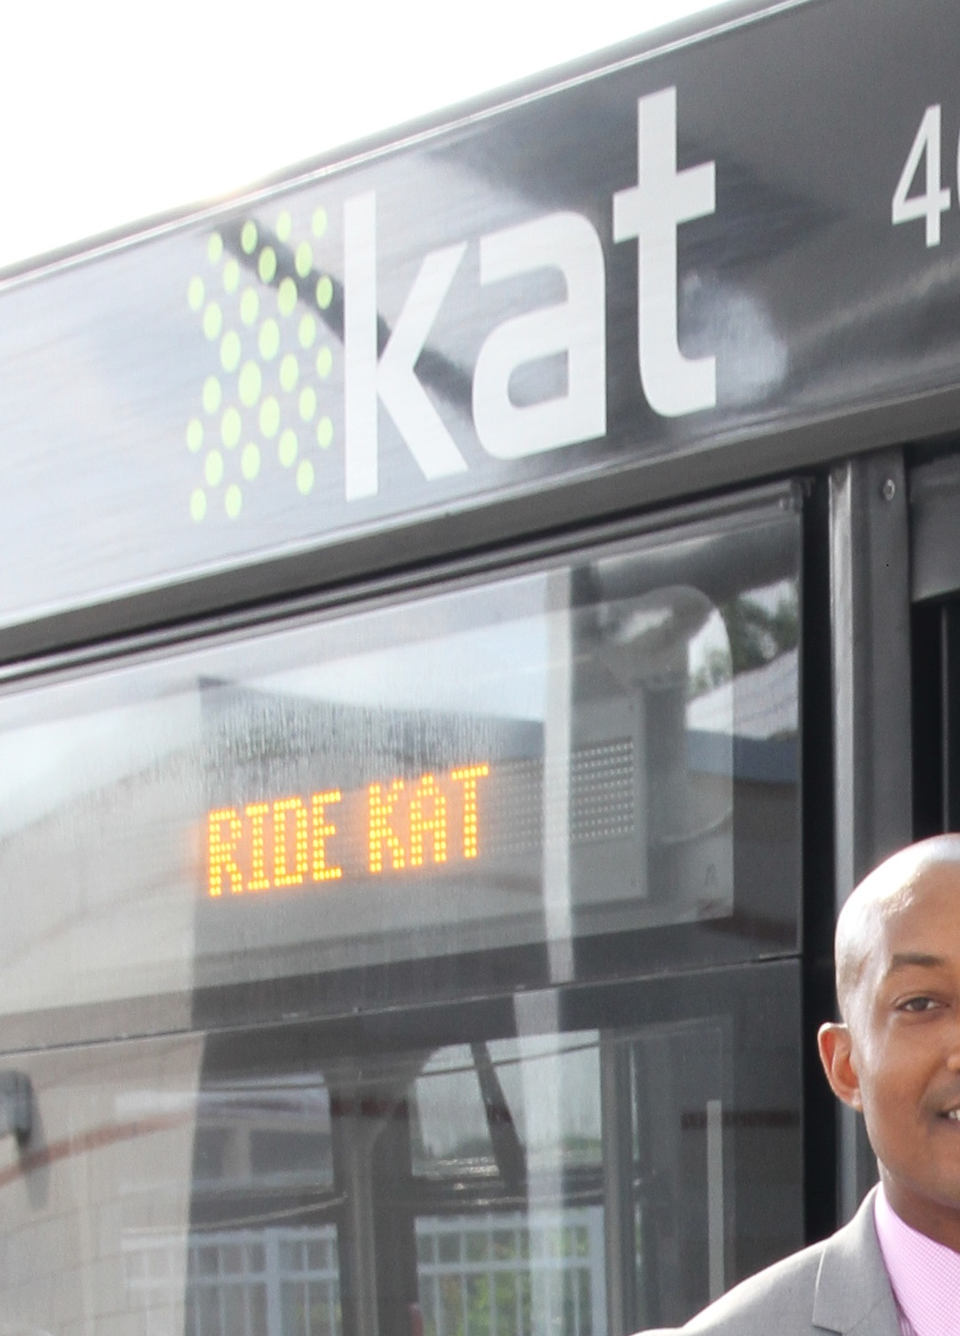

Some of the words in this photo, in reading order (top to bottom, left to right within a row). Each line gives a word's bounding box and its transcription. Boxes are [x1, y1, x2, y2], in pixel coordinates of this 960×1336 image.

[344, 86, 716, 502] kat
[208, 789, 343, 897] RIDE
[368, 764, 489, 874] KAT
